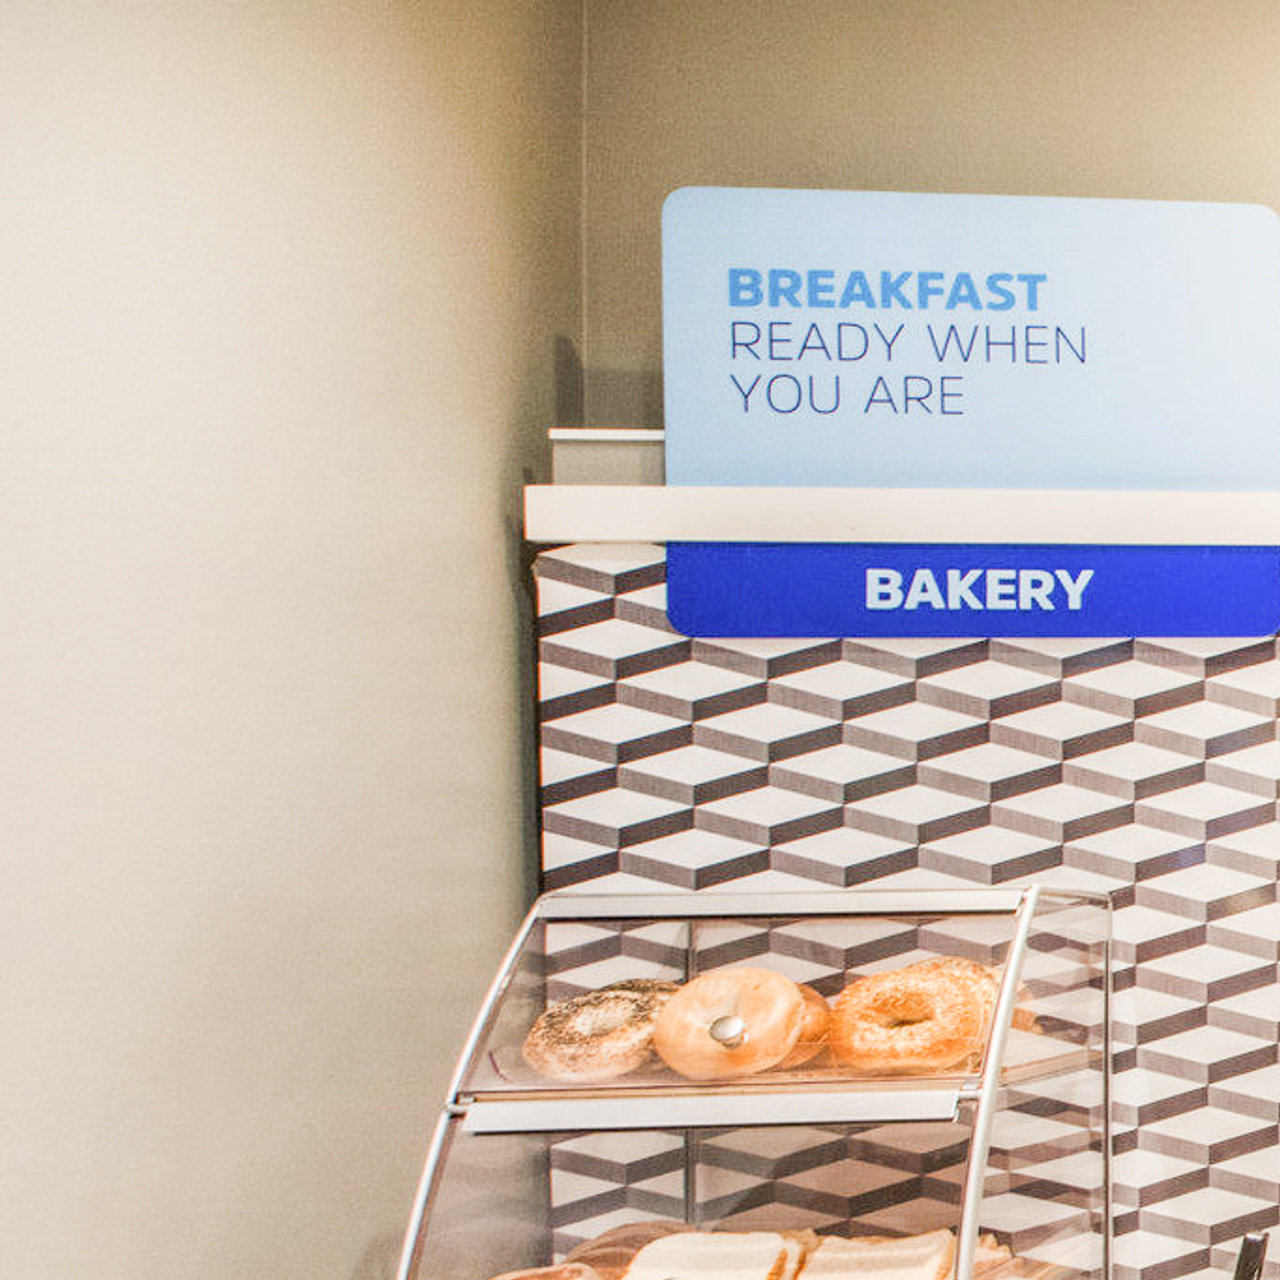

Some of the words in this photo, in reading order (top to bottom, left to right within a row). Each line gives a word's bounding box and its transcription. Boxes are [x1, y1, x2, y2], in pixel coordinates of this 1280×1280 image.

[728, 267, 1047, 311] BREAKFAST
[730, 321, 904, 362] READY
[926, 323, 1087, 364] WHEN
[730, 373, 841, 415] YOU
[864, 375, 965, 415] ARE
[865, 568, 1095, 611] BAKERY
